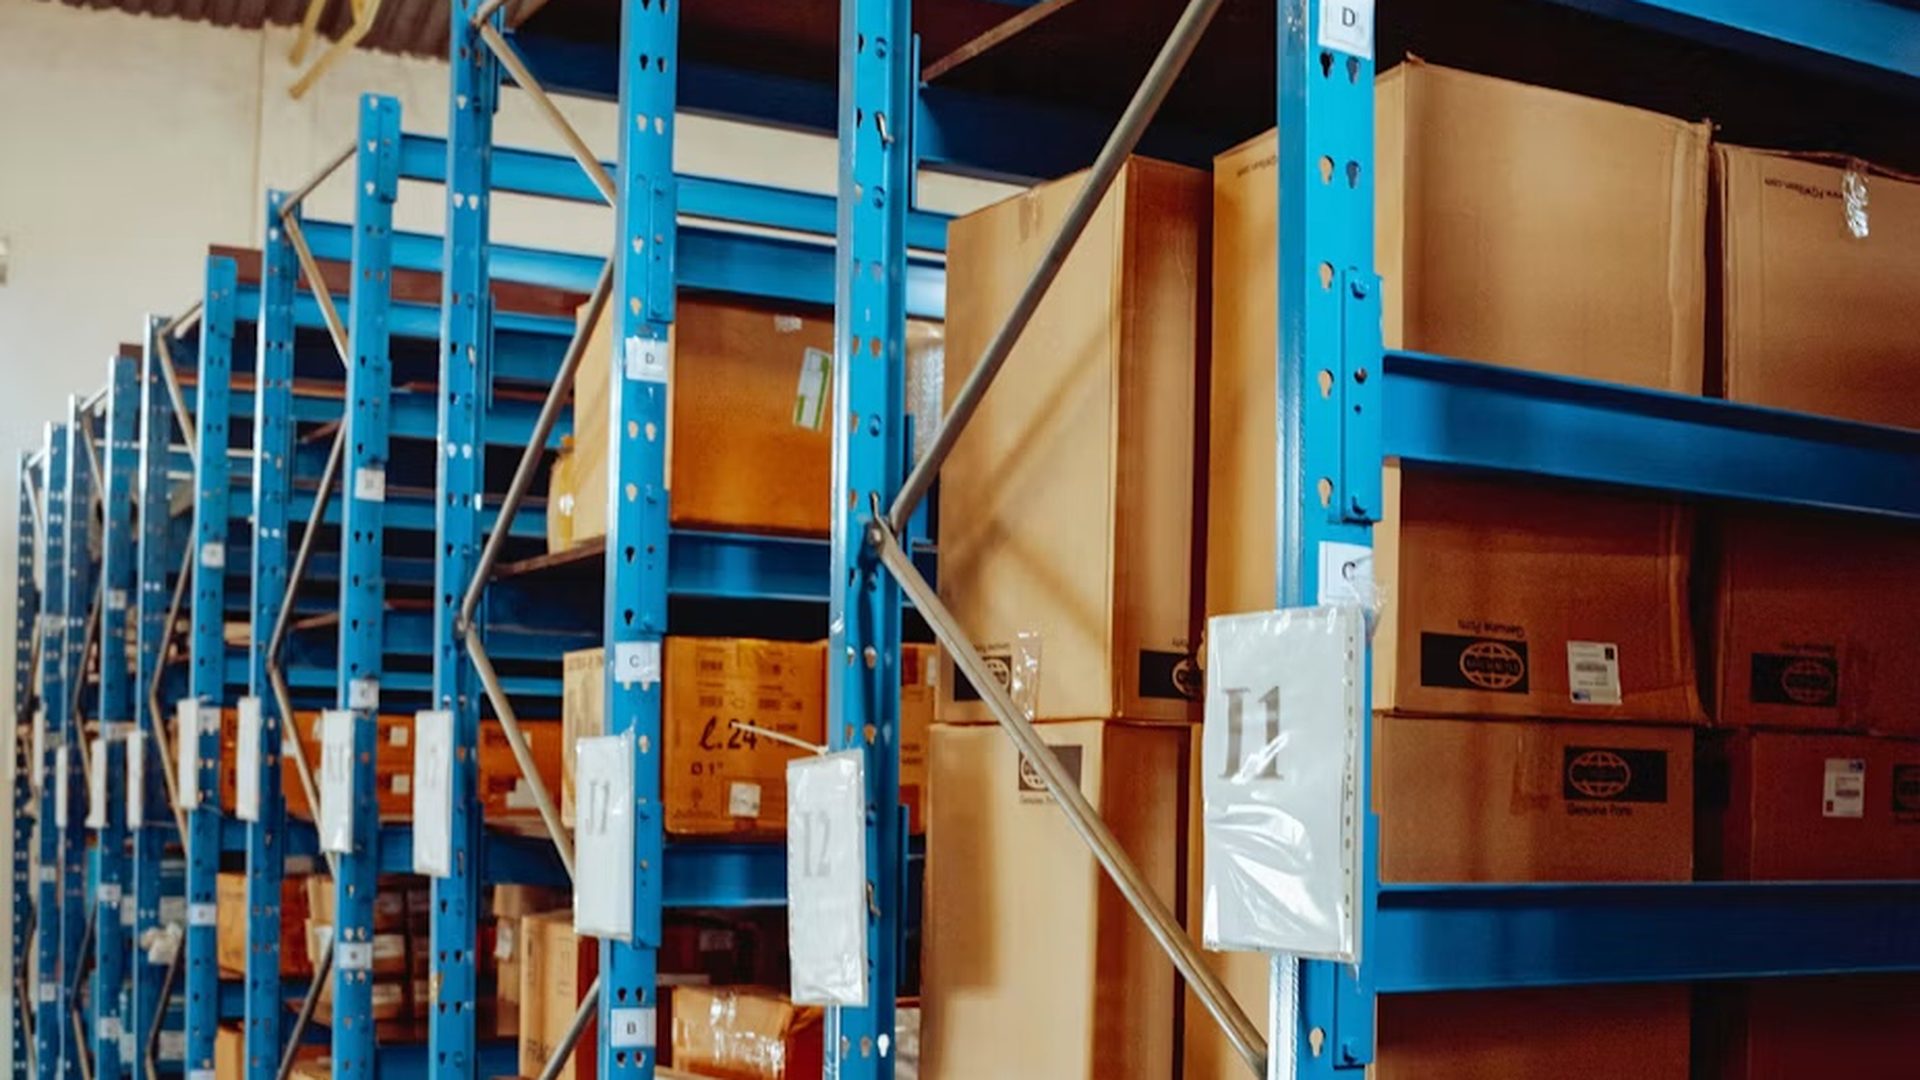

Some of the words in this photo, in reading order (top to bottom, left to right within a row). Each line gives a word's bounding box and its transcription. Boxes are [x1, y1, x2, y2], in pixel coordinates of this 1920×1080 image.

[1341, 6, 1356, 28] D
[645, 352, 655, 365] D
[1341, 561, 1356, 582] C
[629, 654, 641, 669] C
